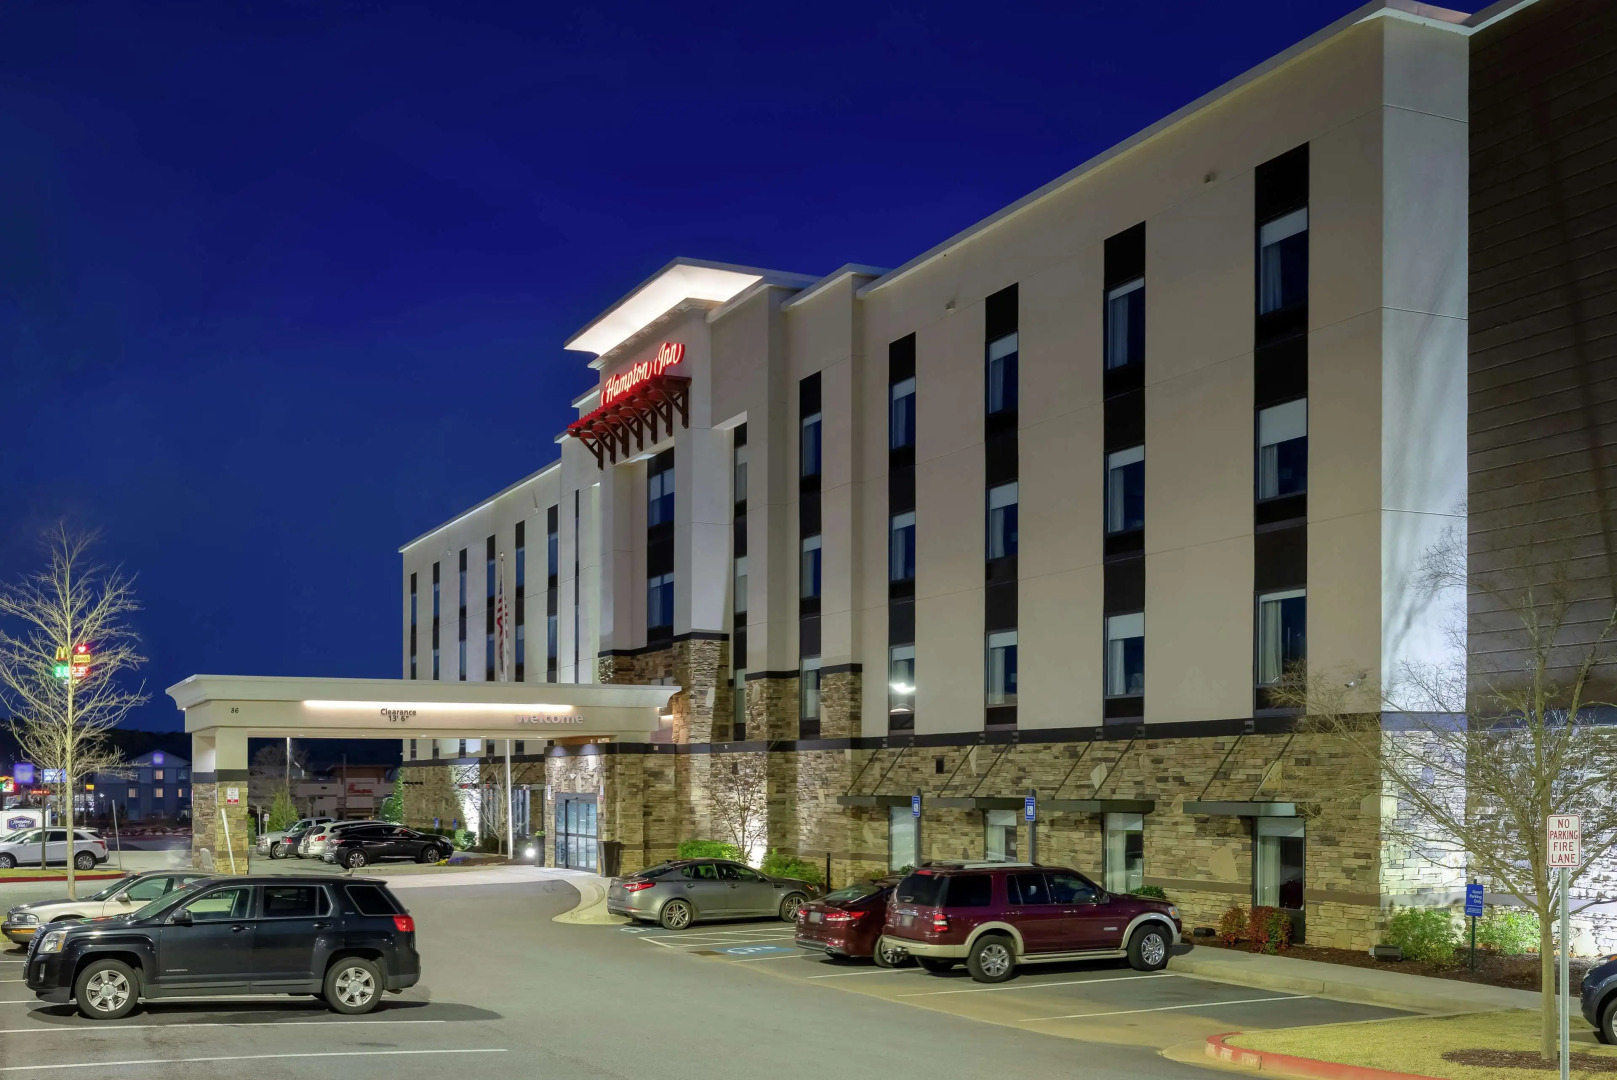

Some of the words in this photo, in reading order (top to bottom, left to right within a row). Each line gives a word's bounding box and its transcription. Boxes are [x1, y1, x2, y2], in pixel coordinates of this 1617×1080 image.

[601, 361, 652, 406] Hampton
[654, 342, 685, 375] Inn
[380, 708, 417, 716] Clearance
[1557, 819, 1570, 829] NO
[1550, 830, 1579, 840] PARKING
[1553, 842, 1574, 852] FIRE
[1551, 853, 1576, 864] LANE
